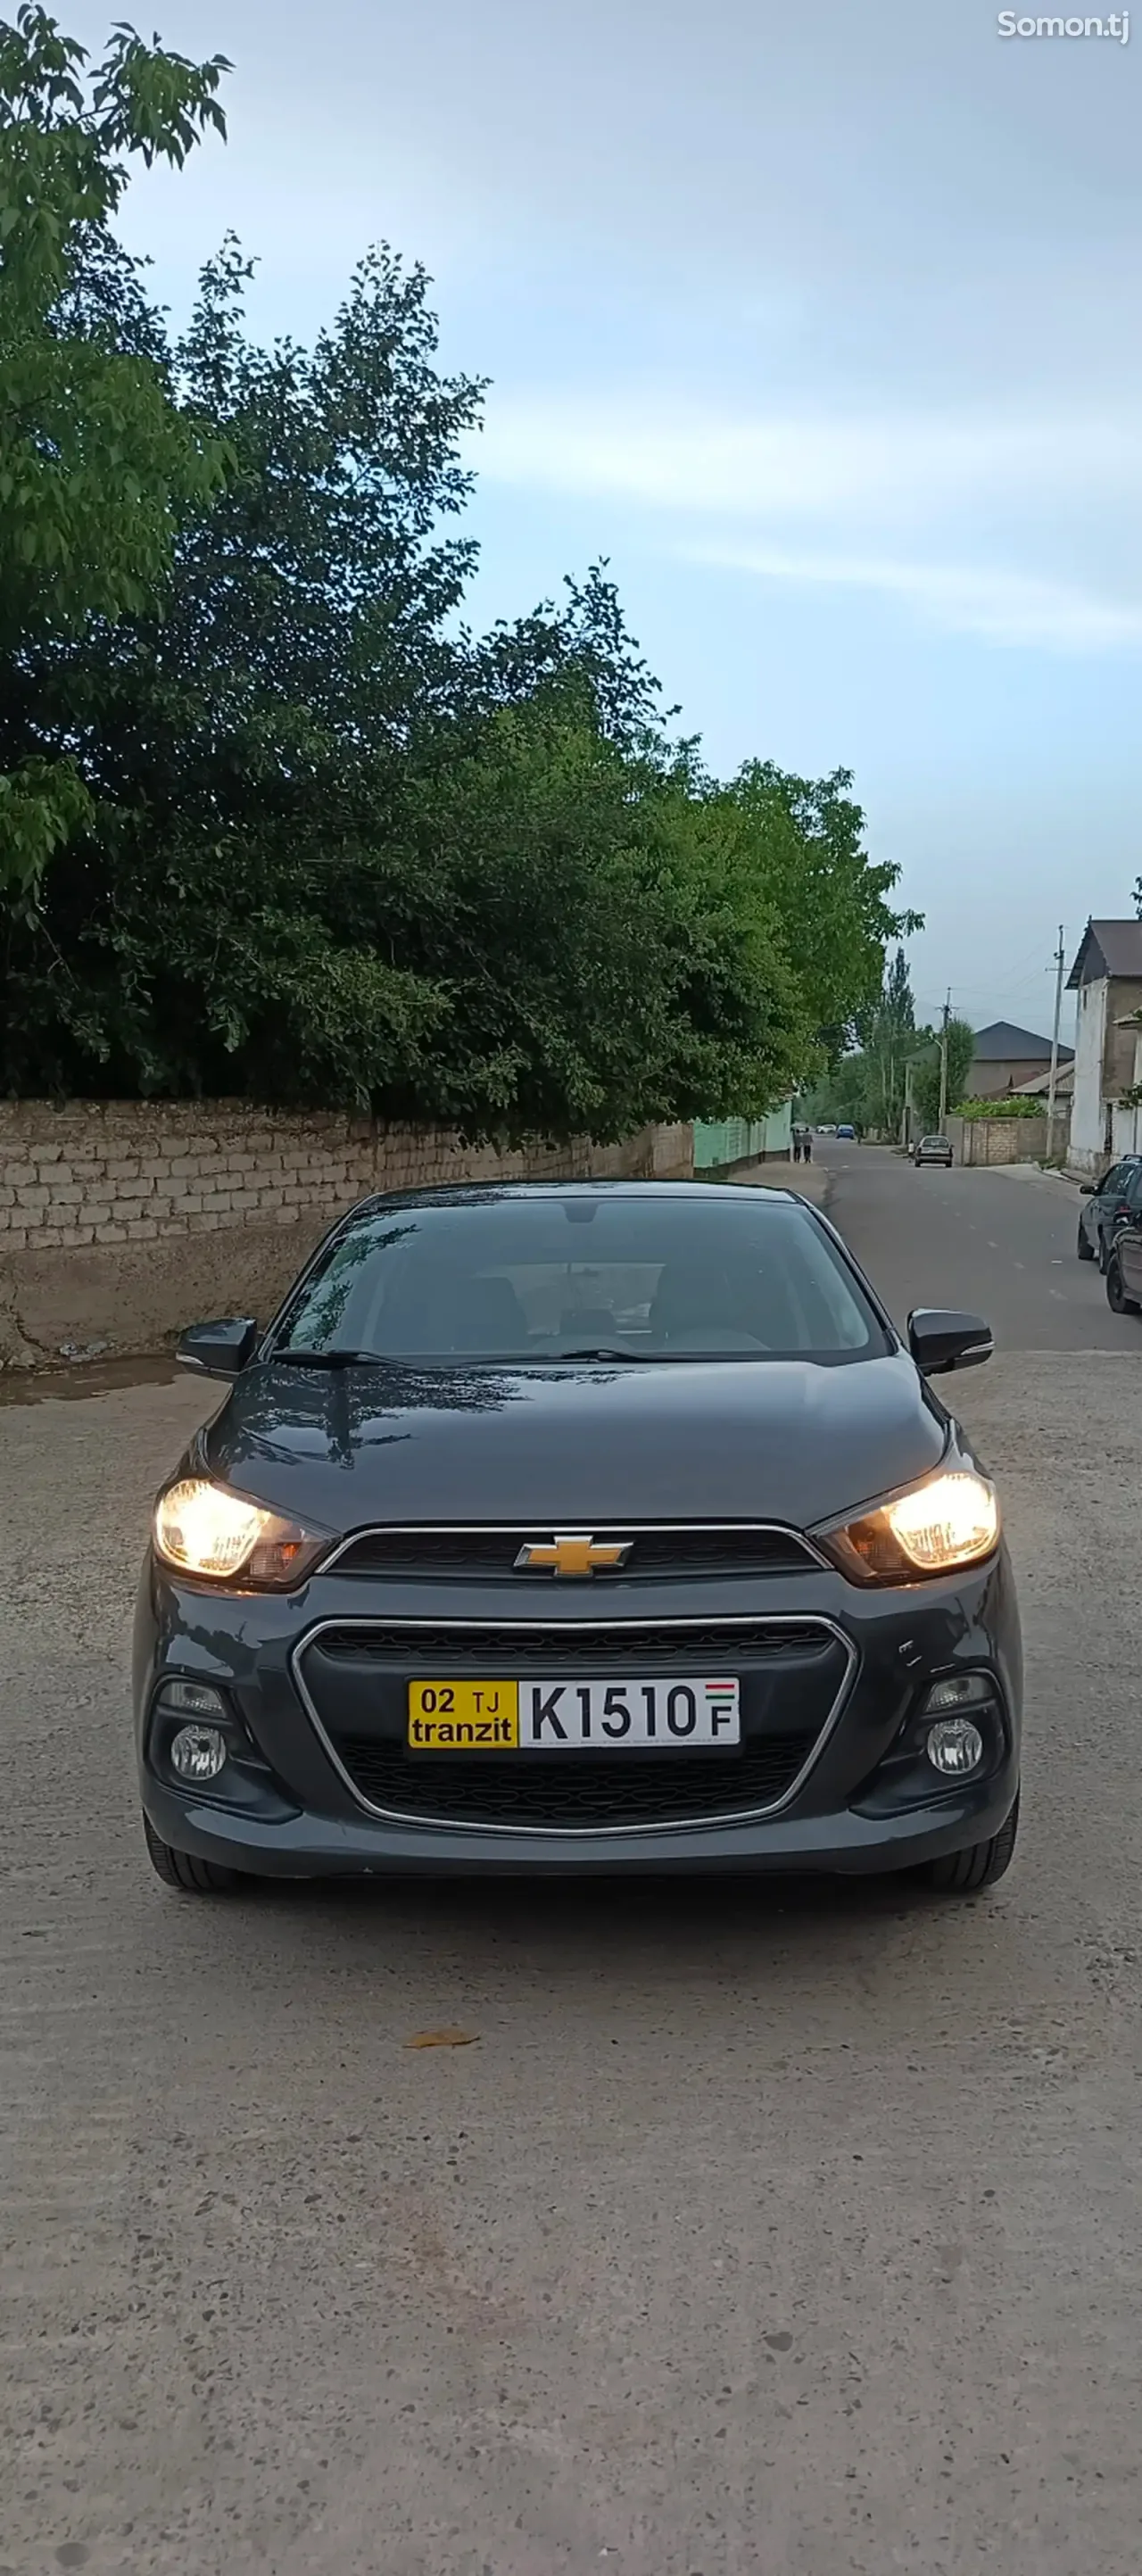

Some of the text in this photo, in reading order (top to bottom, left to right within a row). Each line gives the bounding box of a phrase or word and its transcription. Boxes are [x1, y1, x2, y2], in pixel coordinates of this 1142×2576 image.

[421, 1688, 500, 1713] 02 TJ
[533, 1685, 697, 1739] K1510
[411, 1717, 511, 1743] tranzit
[711, 1706, 732, 1736] F
